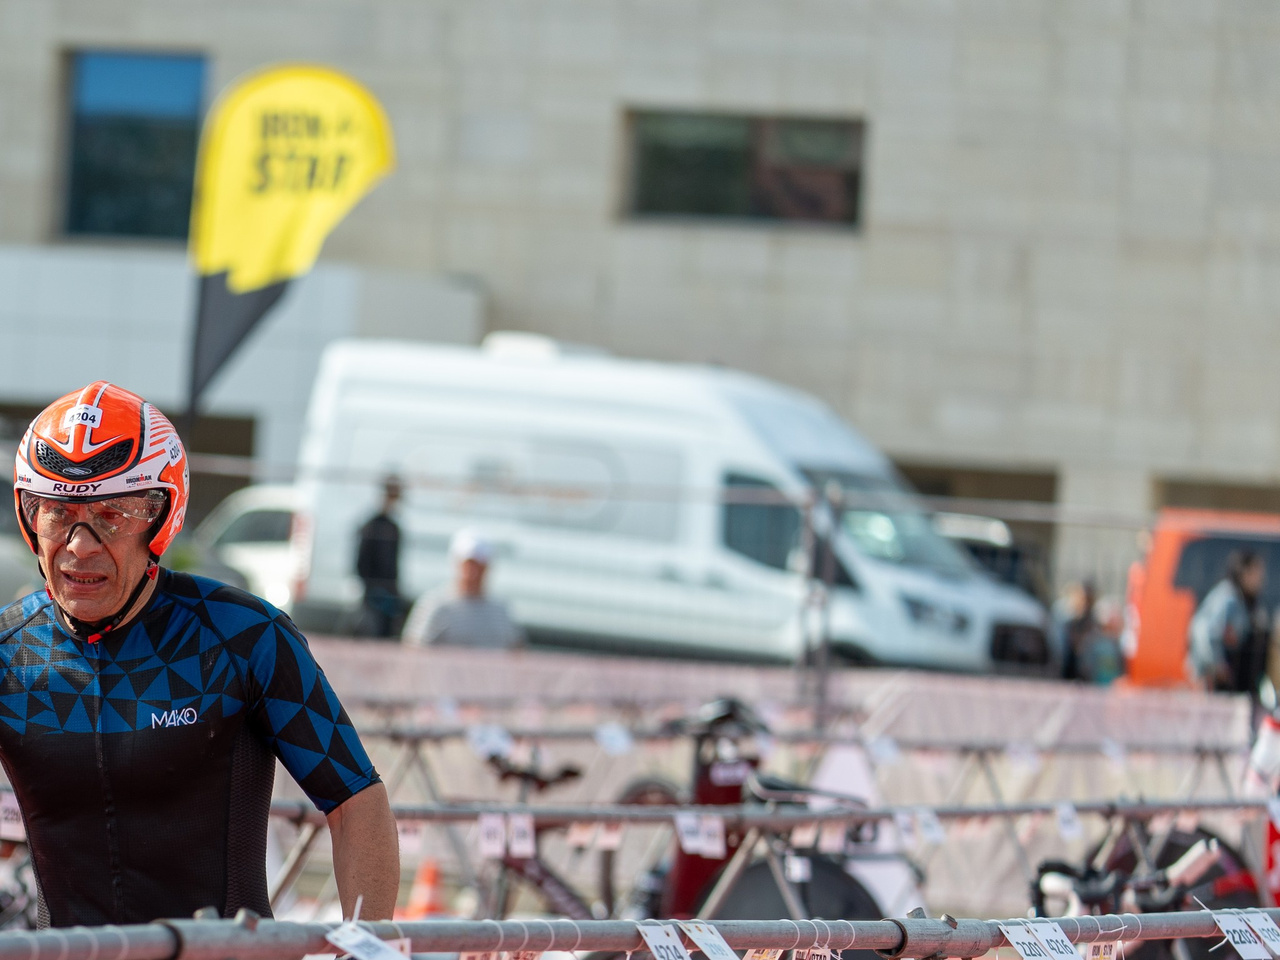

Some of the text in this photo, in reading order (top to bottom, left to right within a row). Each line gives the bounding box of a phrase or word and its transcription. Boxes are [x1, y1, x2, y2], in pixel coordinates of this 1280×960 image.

[53, 483, 102, 493] RUDY
[151, 707, 198, 729] MAKO
[1226, 929, 1258, 944] 2203
[1016, 941, 1047, 957] 2201
[1046, 939, 1074, 955] 4216
